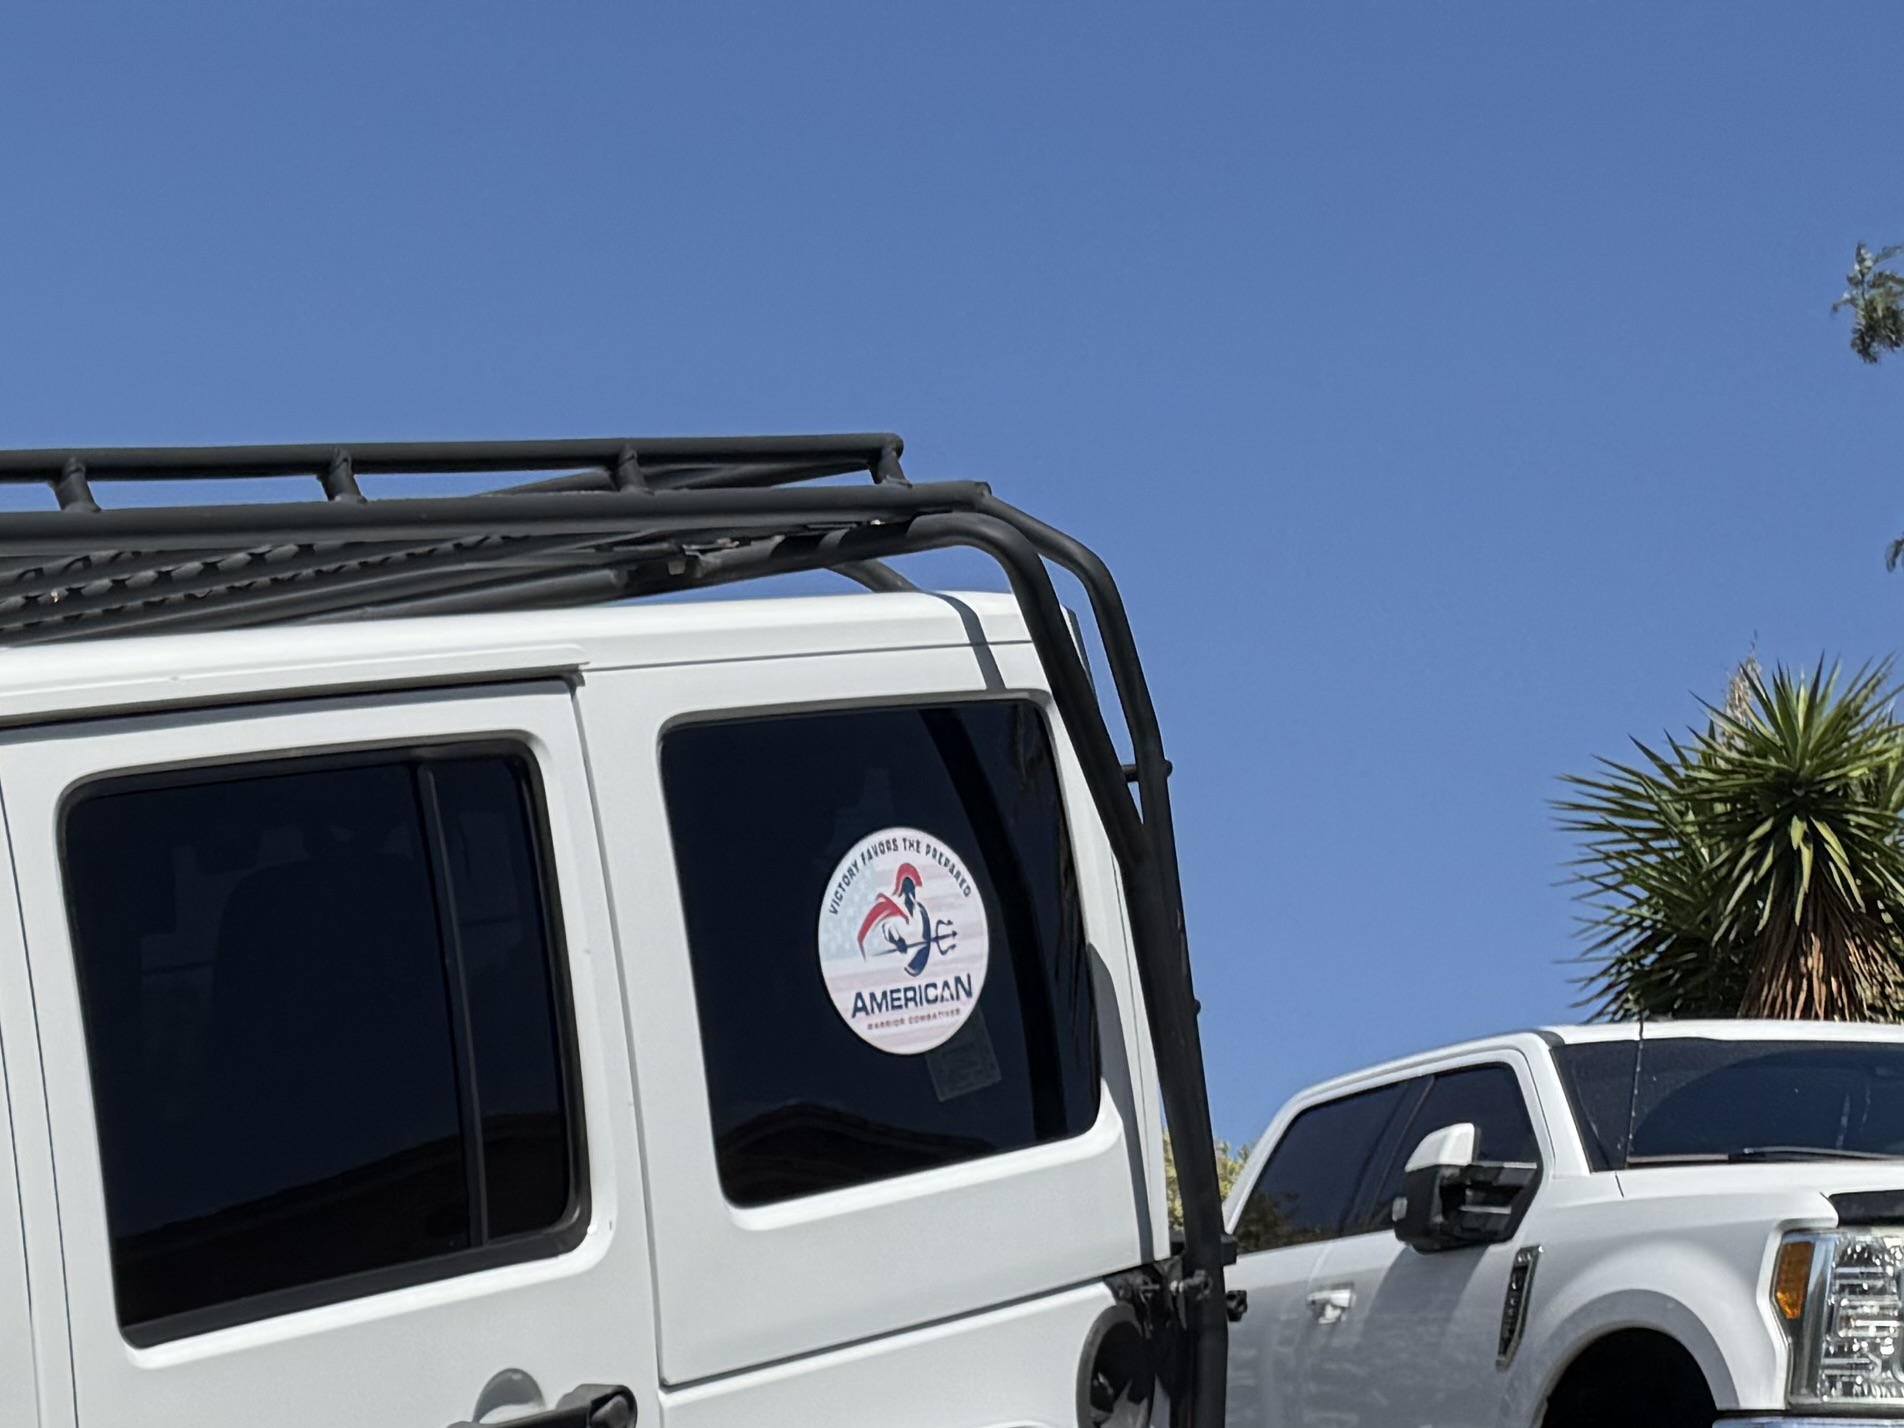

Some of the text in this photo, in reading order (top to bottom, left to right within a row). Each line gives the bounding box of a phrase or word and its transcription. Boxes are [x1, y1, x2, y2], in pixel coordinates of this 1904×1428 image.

[828, 837, 971, 916] VICTORY FAVORS THE PREPARED
[850, 972, 974, 1020] AMERICAN
